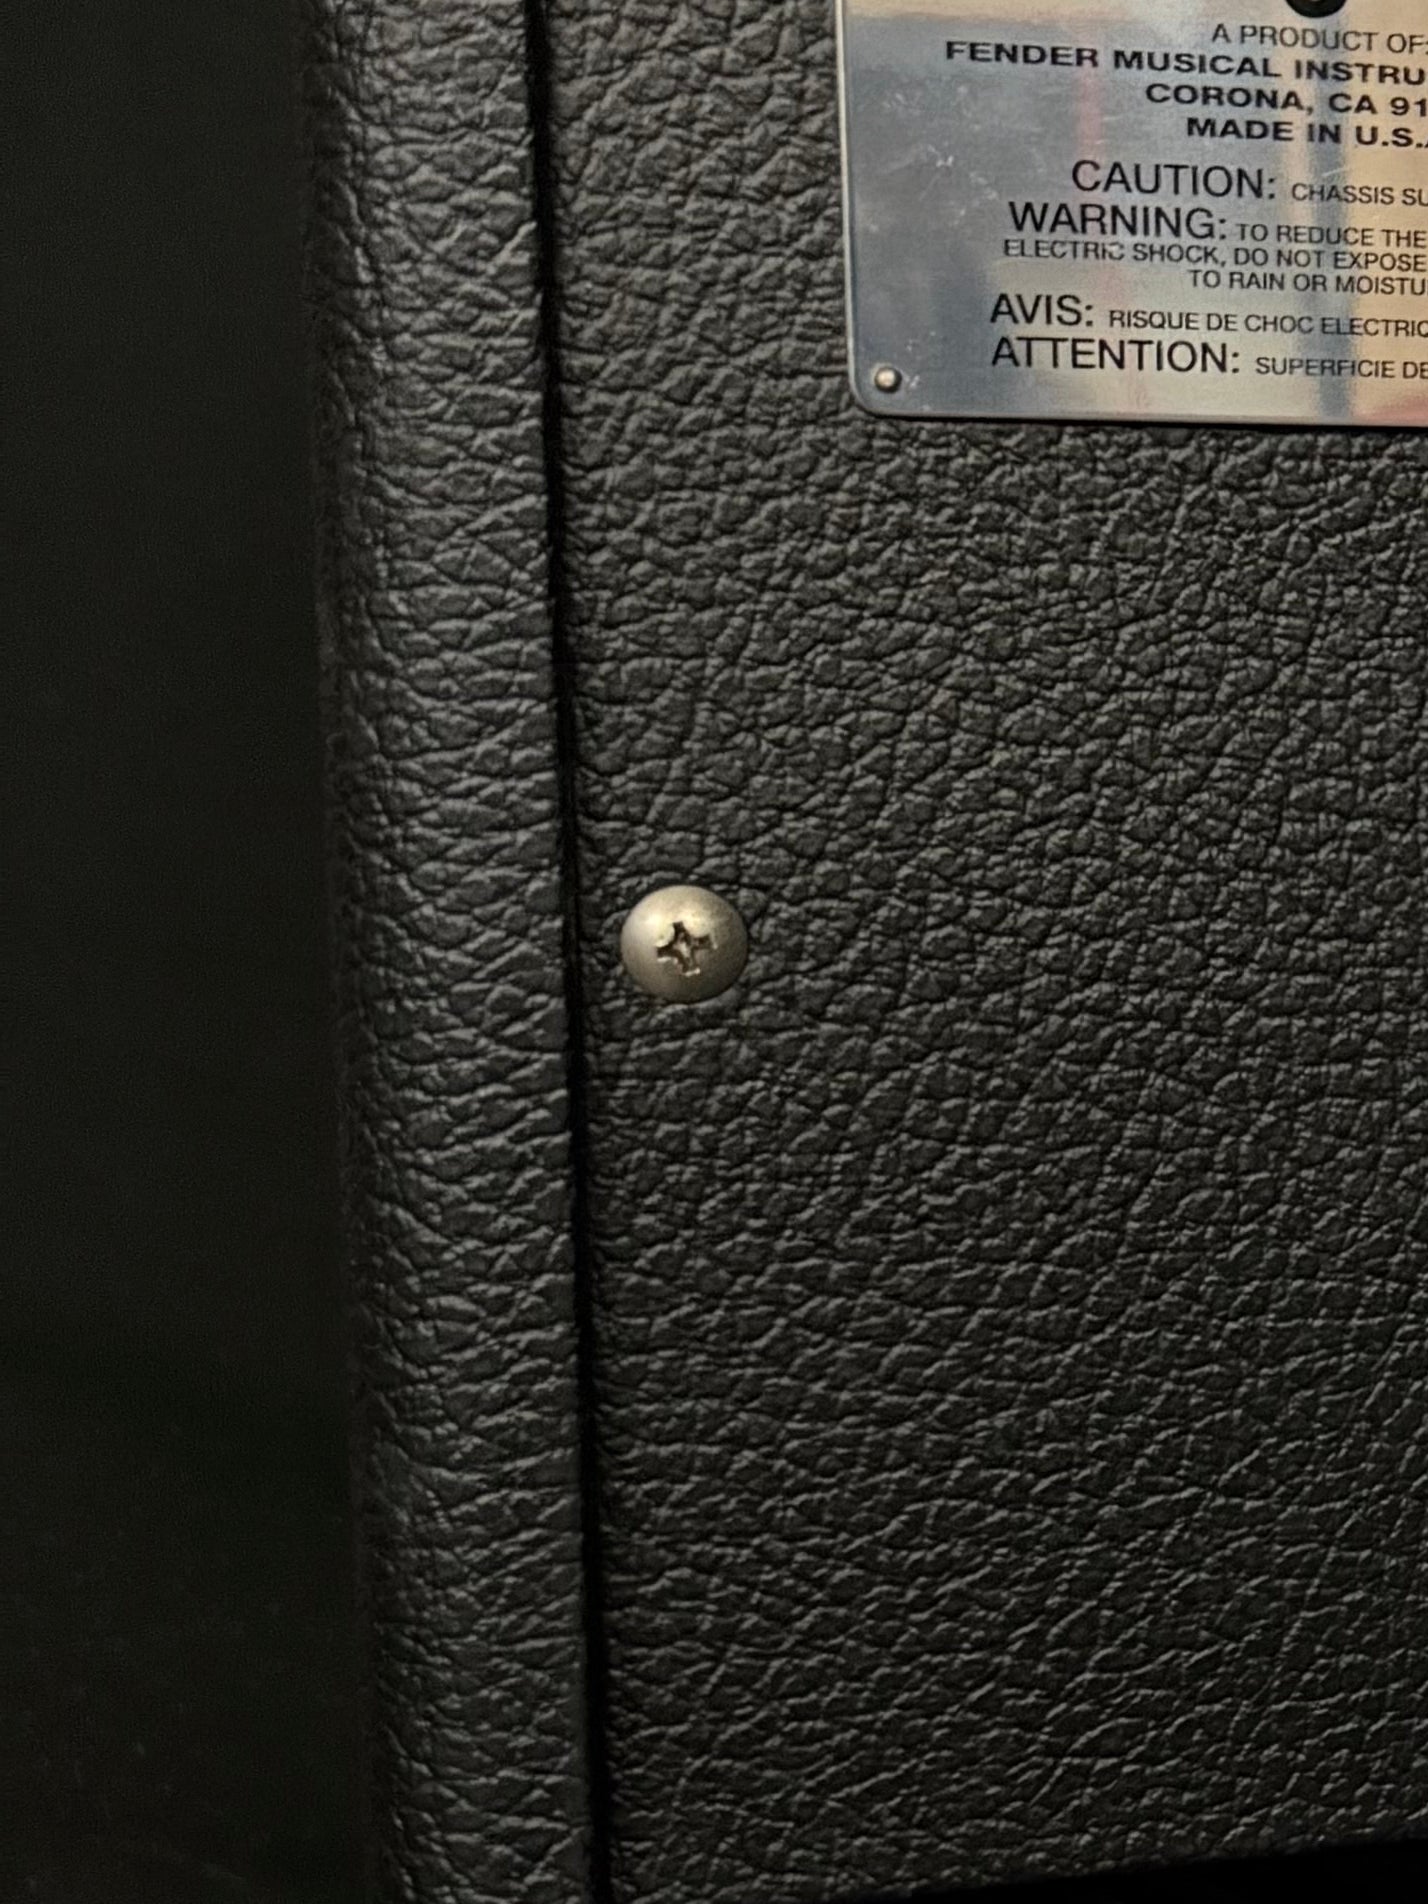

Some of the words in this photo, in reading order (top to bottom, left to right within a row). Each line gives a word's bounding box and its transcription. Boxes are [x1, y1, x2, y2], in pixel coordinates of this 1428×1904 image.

[1211, 23, 1232, 44] A
[1240, 24, 1378, 53] PRODUCT
[945, 40, 1100, 68] FENDER
[1113, 49, 1282, 78] MUSICAL
[1145, 83, 1313, 116] CORONA,
[1328, 92, 1377, 116] CA
[1187, 117, 1293, 143] MADE
[1307, 122, 1341, 145] IN
[1072, 159, 1276, 200] CAUTION:
[1291, 182, 1395, 206] CHASSIS
[1008, 201, 1228, 241] WARNING:
[1235, 223, 1269, 243] TO
[1276, 224, 1374, 248] REDUCE
[1381, 228, 1427, 249] THE
[1003, 238, 1126, 261] ELECTRIC
[1132, 242, 1226, 268] SHOCK,
[1234, 247, 1270, 267] DO
[1277, 249, 1326, 269] NOT
[1333, 251, 1427, 274] EXPOSE
[1189, 269, 1221, 289] TO
[1229, 270, 1285, 292] RAIN
[1292, 273, 1328, 294] OR
[989, 292, 1095, 328] AVIS:
[1108, 309, 1199, 332] RISQUE
[1206, 312, 1239, 332] DE
[1244, 313, 1315, 336] CHOC
[991, 336, 1240, 375] ATTENTION:
[1254, 355, 1397, 380] SUPERFICIE
